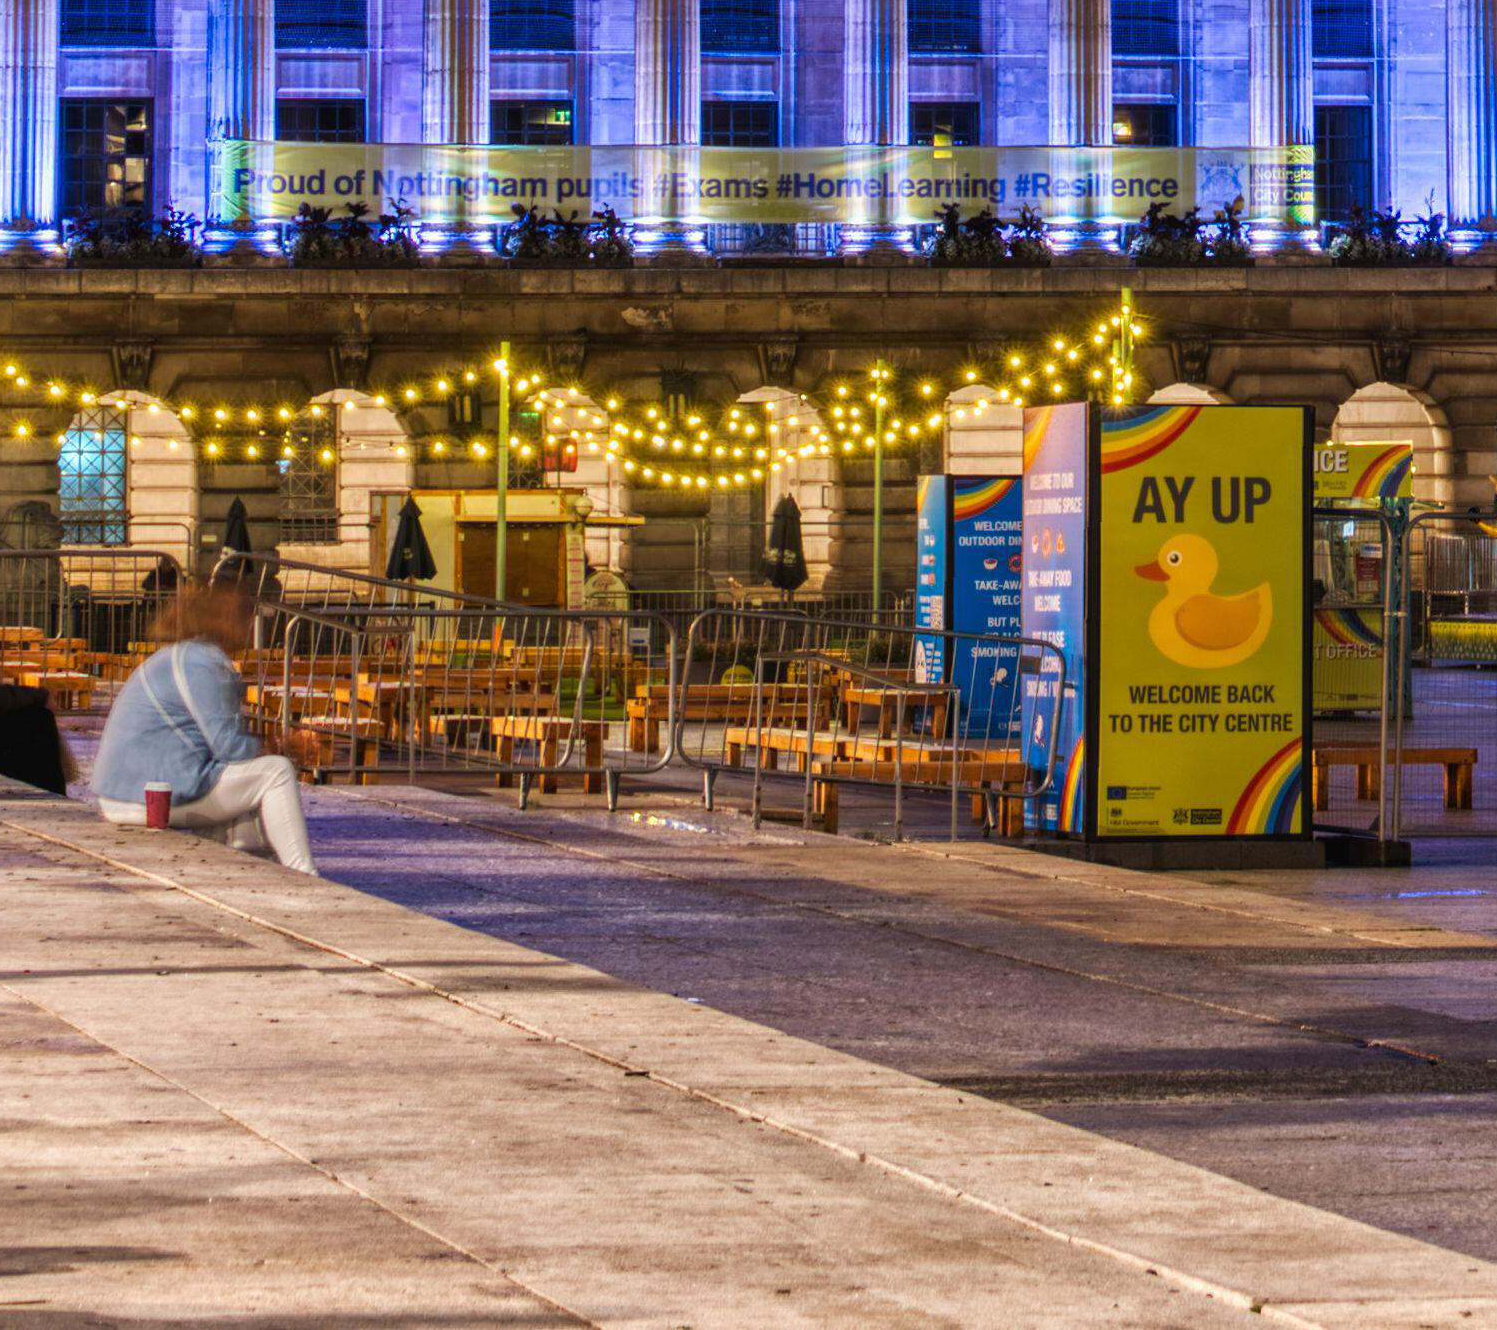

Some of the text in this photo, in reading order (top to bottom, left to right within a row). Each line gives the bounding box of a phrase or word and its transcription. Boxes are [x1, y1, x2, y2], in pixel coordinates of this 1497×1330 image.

[233, 168, 1179, 203] Proud of Nottingham pupils #Exams #HomeLearning #Resilience
[1314, 450, 1348, 472] ICE
[1064, 496, 1082, 514] SPACE
[1132, 476, 1271, 523] AY UP
[974, 521, 1022, 532] WELCOME
[959, 536, 1005, 547] OUTDOOR
[987, 617, 1007, 627] BUT
[971, 647, 1017, 658] SMOKING
[1326, 642, 1377, 660] OFFICE
[1129, 684, 1275, 704] WELCOME BACK
[1109, 713, 1293, 733] TO THE CITY CENTRE
